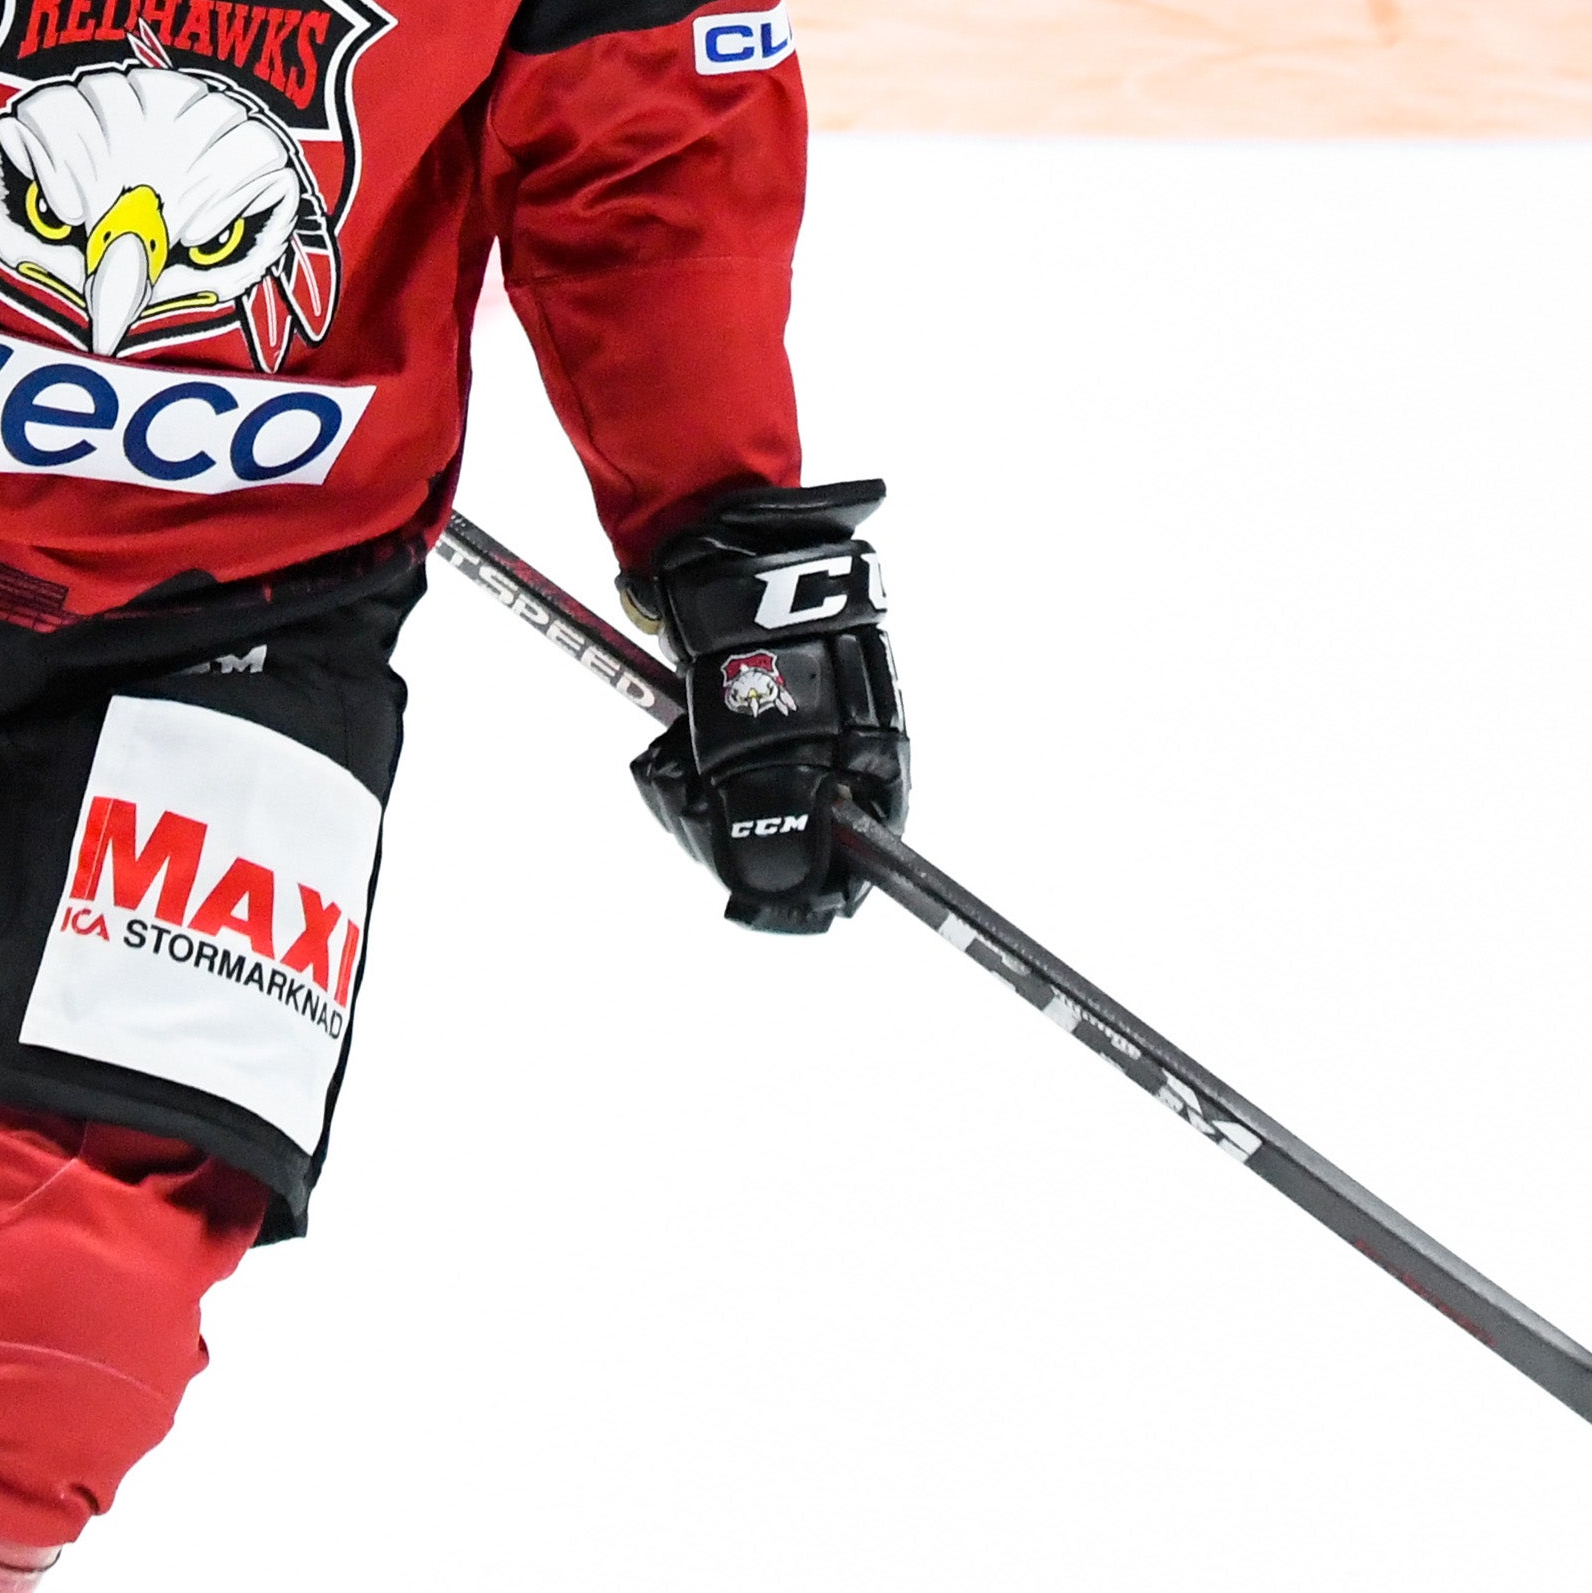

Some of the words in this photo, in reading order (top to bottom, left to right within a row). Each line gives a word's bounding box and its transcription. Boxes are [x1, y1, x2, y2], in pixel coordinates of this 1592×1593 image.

[705, 22, 793, 64] CL
[437, 533, 657, 710] TSPEED
[729, 813, 810, 839] CCM
[69, 795, 361, 1009] MAXI
[60, 906, 111, 942] ICA
[122, 919, 345, 1040] STORMARKNAD
